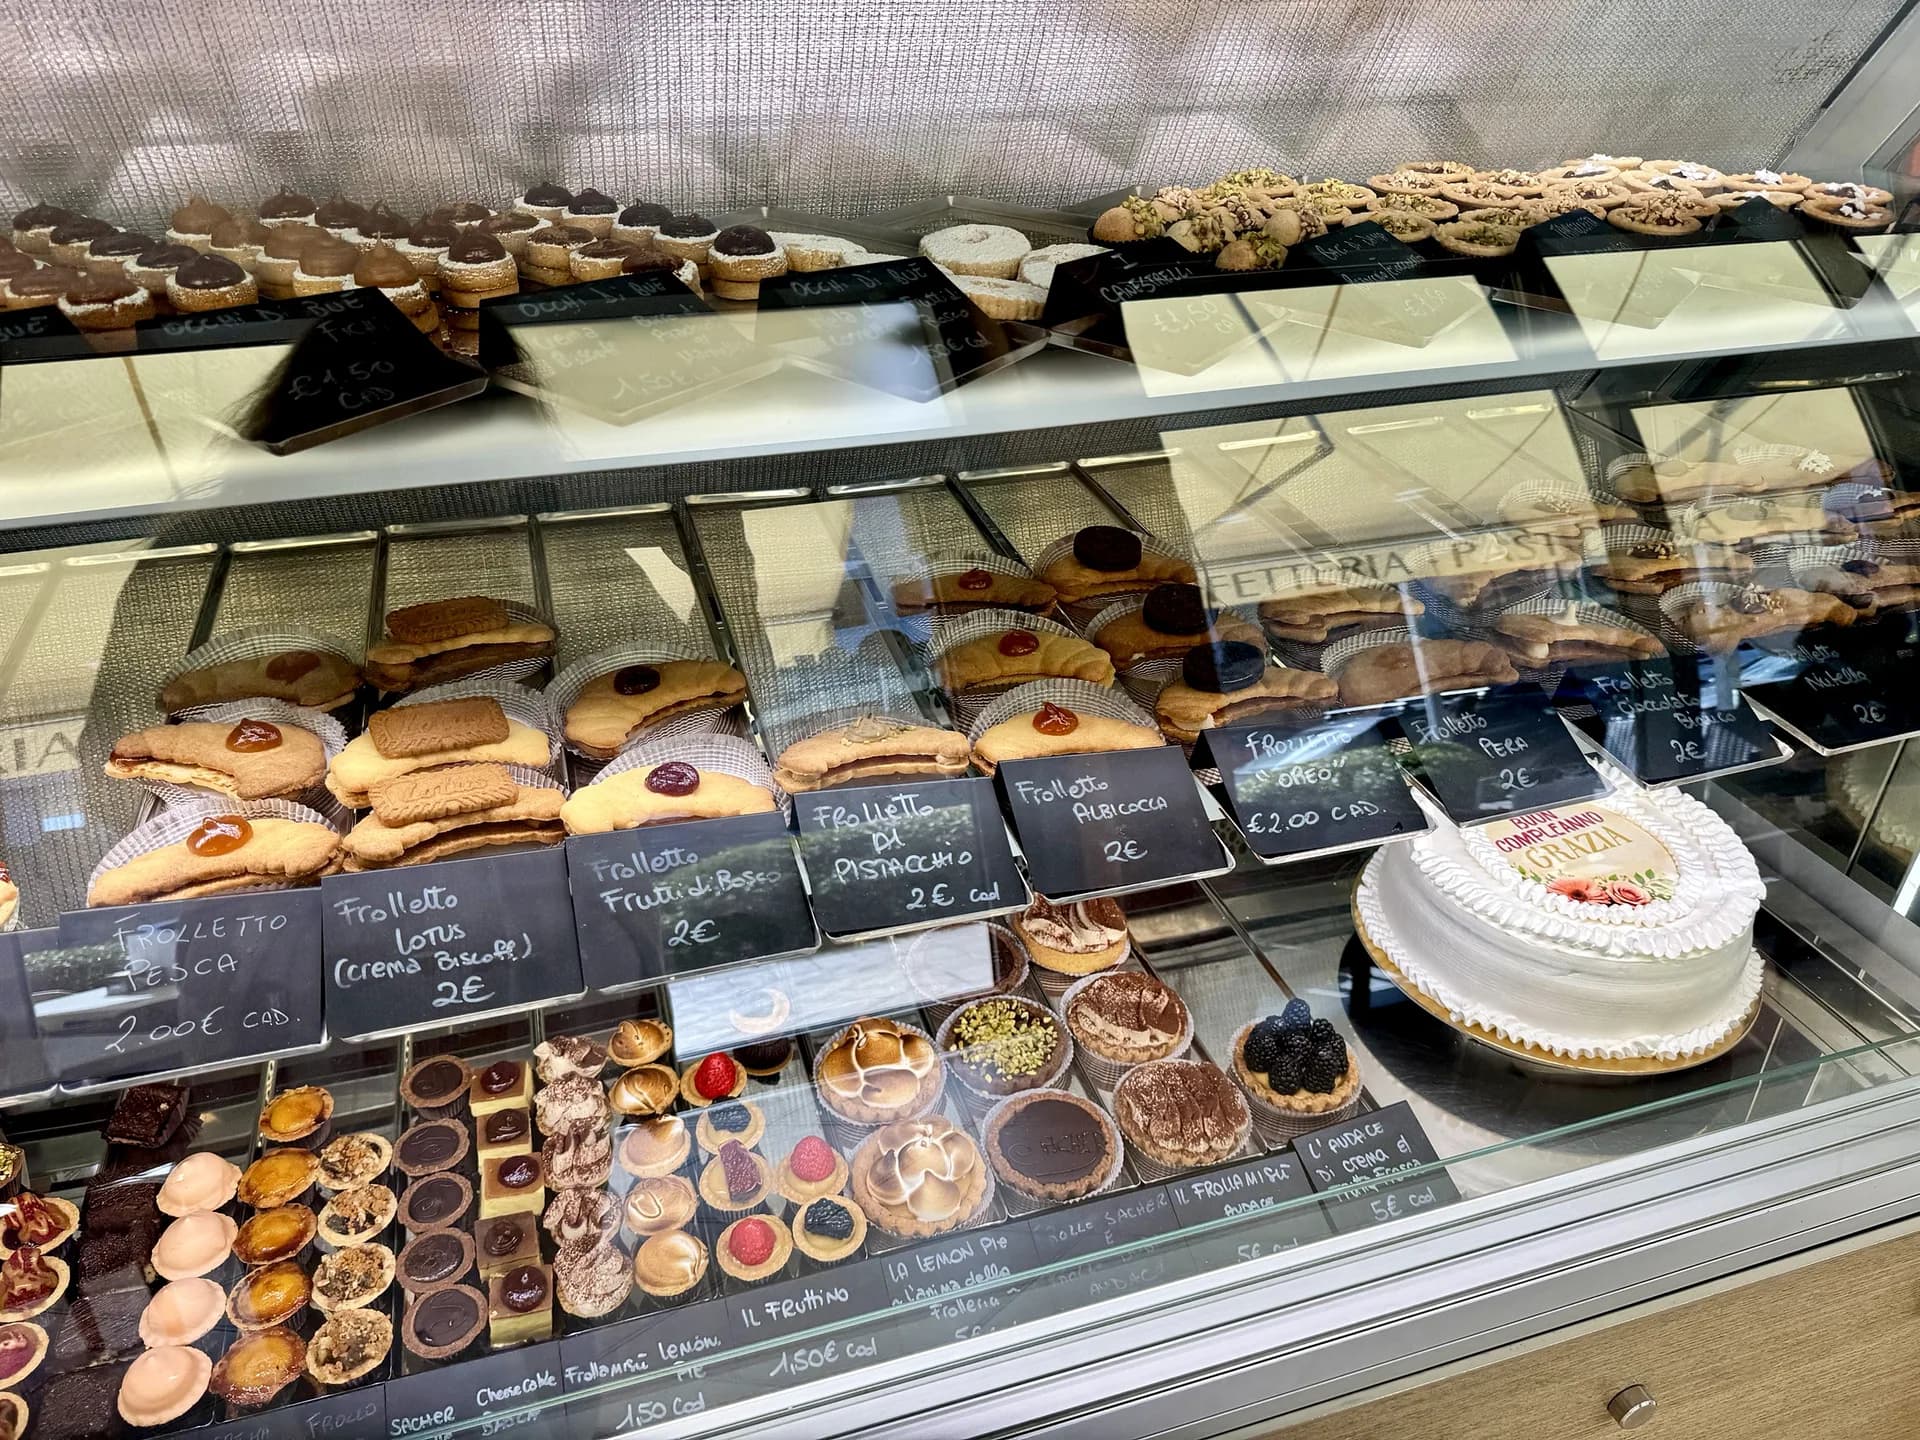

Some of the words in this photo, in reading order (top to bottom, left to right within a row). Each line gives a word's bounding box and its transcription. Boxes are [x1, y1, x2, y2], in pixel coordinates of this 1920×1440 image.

[0, 315, 48, 341] UE
[1804, 666, 1868, 692] Nutella
[1853, 703, 1887, 724] 2€
[1478, 736, 1529, 760] PERA
[1669, 739, 1709, 764] 2€
[1015, 774, 1110, 806] Frolletto
[1500, 768, 1539, 792] 2€
[1072, 796, 1169, 825] ALBICOCCA
[1494, 810, 1605, 854] COMPLEANNO
[1524, 824, 1634, 870] GRAZIA
[587, 846, 699, 883] Frolletto
[1103, 839, 1149, 863] 2€
[333, 884, 459, 926] Frolletto
[599, 882, 684, 914] Frutti
[687, 875, 714, 898] di
[714, 868, 783, 897] Bosco
[113, 911, 288, 952] FROLLETTO
[667, 919, 722, 948] 2€
[122, 952, 240, 992] PESCA
[431, 975, 496, 1009] 2€
[104, 1006, 226, 1054] 2.00€
[1103, 1192, 1168, 1226] SACHER
[1174, 1187, 1190, 1207] IL
[1369, 1194, 1403, 1222] 5€
[888, 1262, 910, 1283] LA
[915, 1240, 975, 1274] LEMON
[741, 1307, 761, 1329] IL
[768, 1339, 840, 1378] 1,50€
